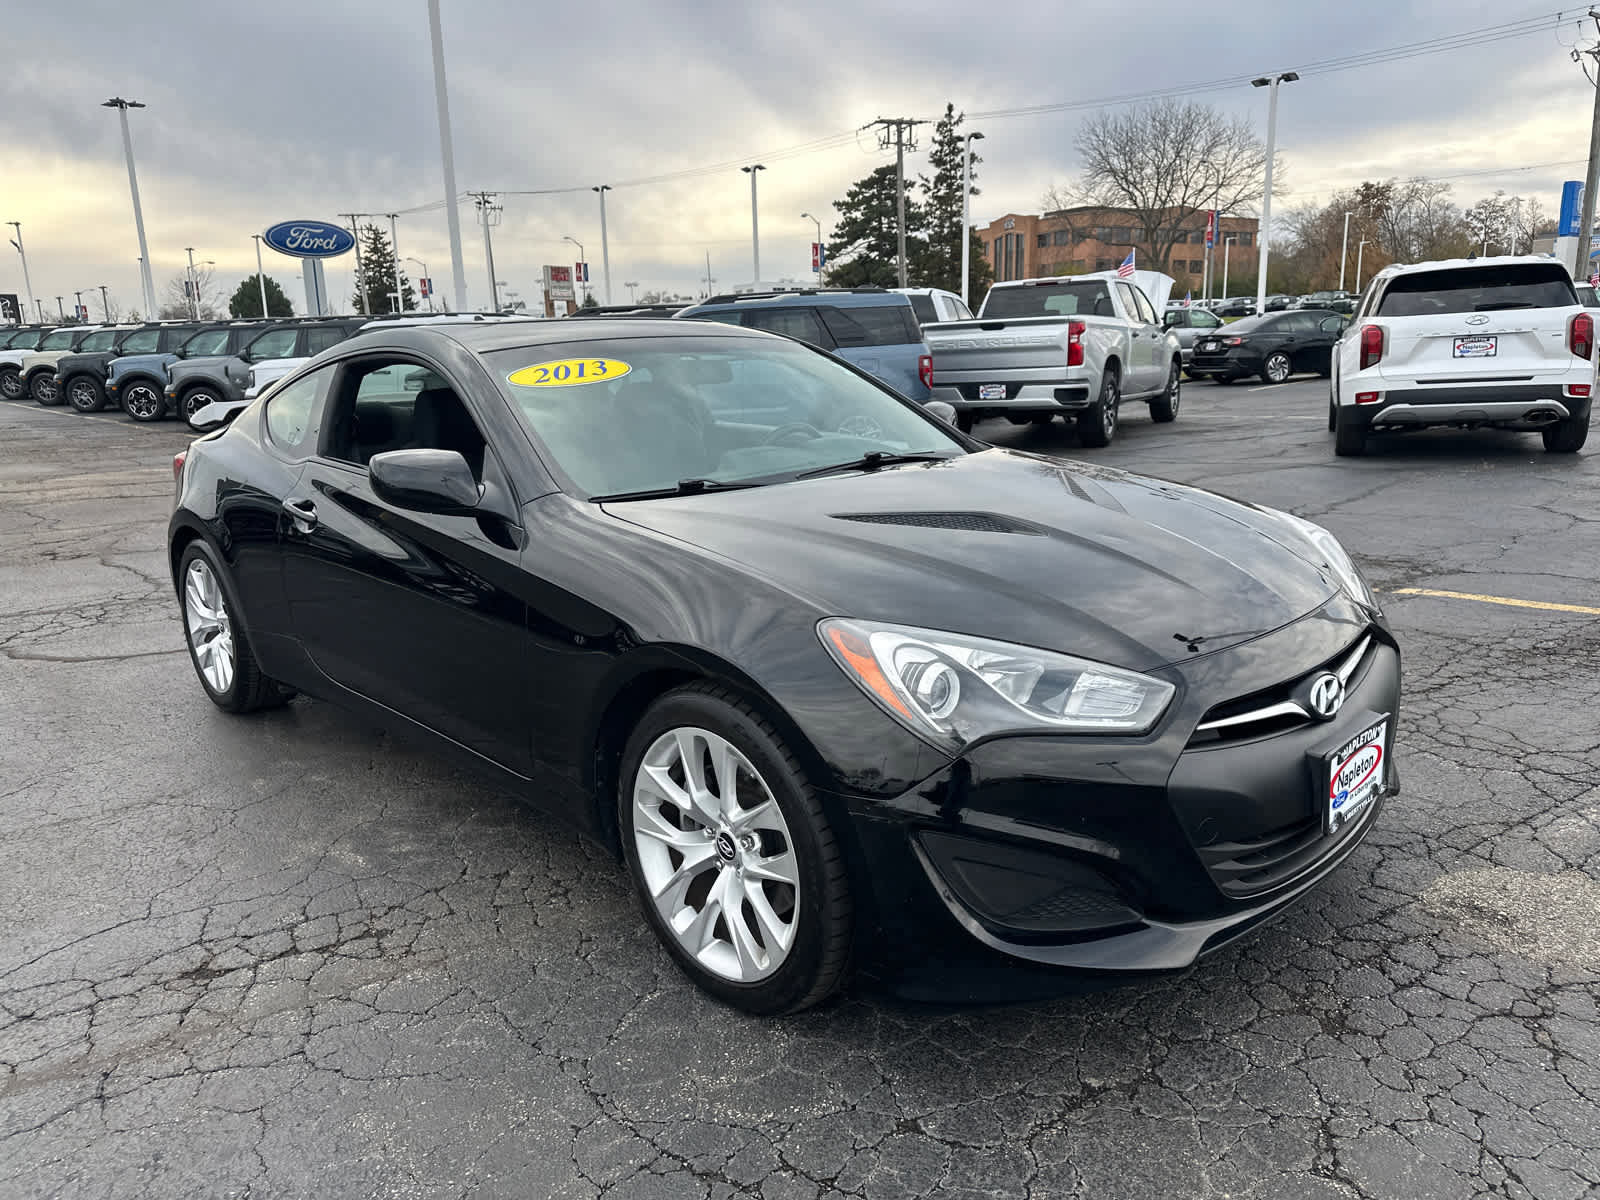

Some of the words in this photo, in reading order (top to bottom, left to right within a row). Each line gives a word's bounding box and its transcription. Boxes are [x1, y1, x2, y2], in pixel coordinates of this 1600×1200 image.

[286, 226, 337, 249] Ford
[534, 361, 607, 384] 2013
[1338, 756, 1374, 791] Napleton
